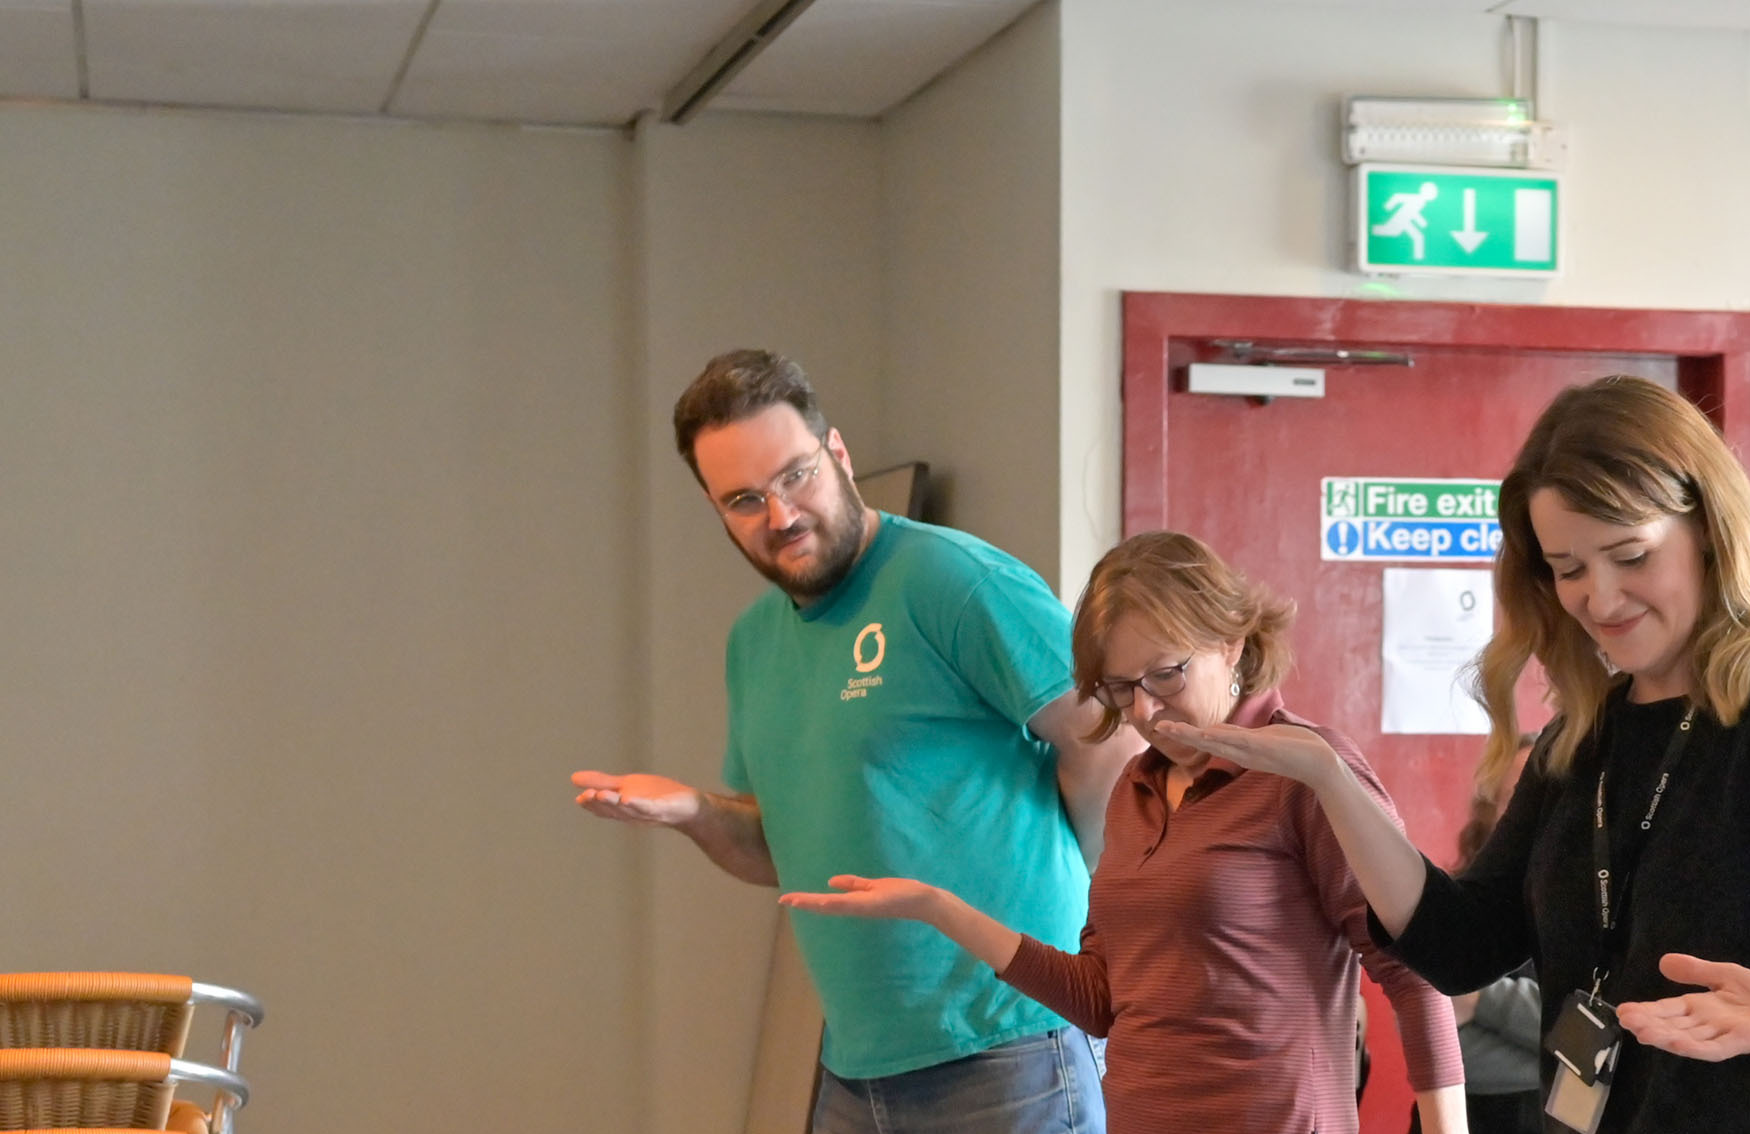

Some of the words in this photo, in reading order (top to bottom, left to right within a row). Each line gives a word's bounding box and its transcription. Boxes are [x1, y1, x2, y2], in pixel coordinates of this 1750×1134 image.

[1367, 486, 1428, 516] Fire
[1437, 488, 1497, 516] exit
[1368, 521, 1452, 556] Keep
[1460, 521, 1504, 552] cle
[847, 676, 883, 689] Scottish
[840, 688, 867, 701] Opera
